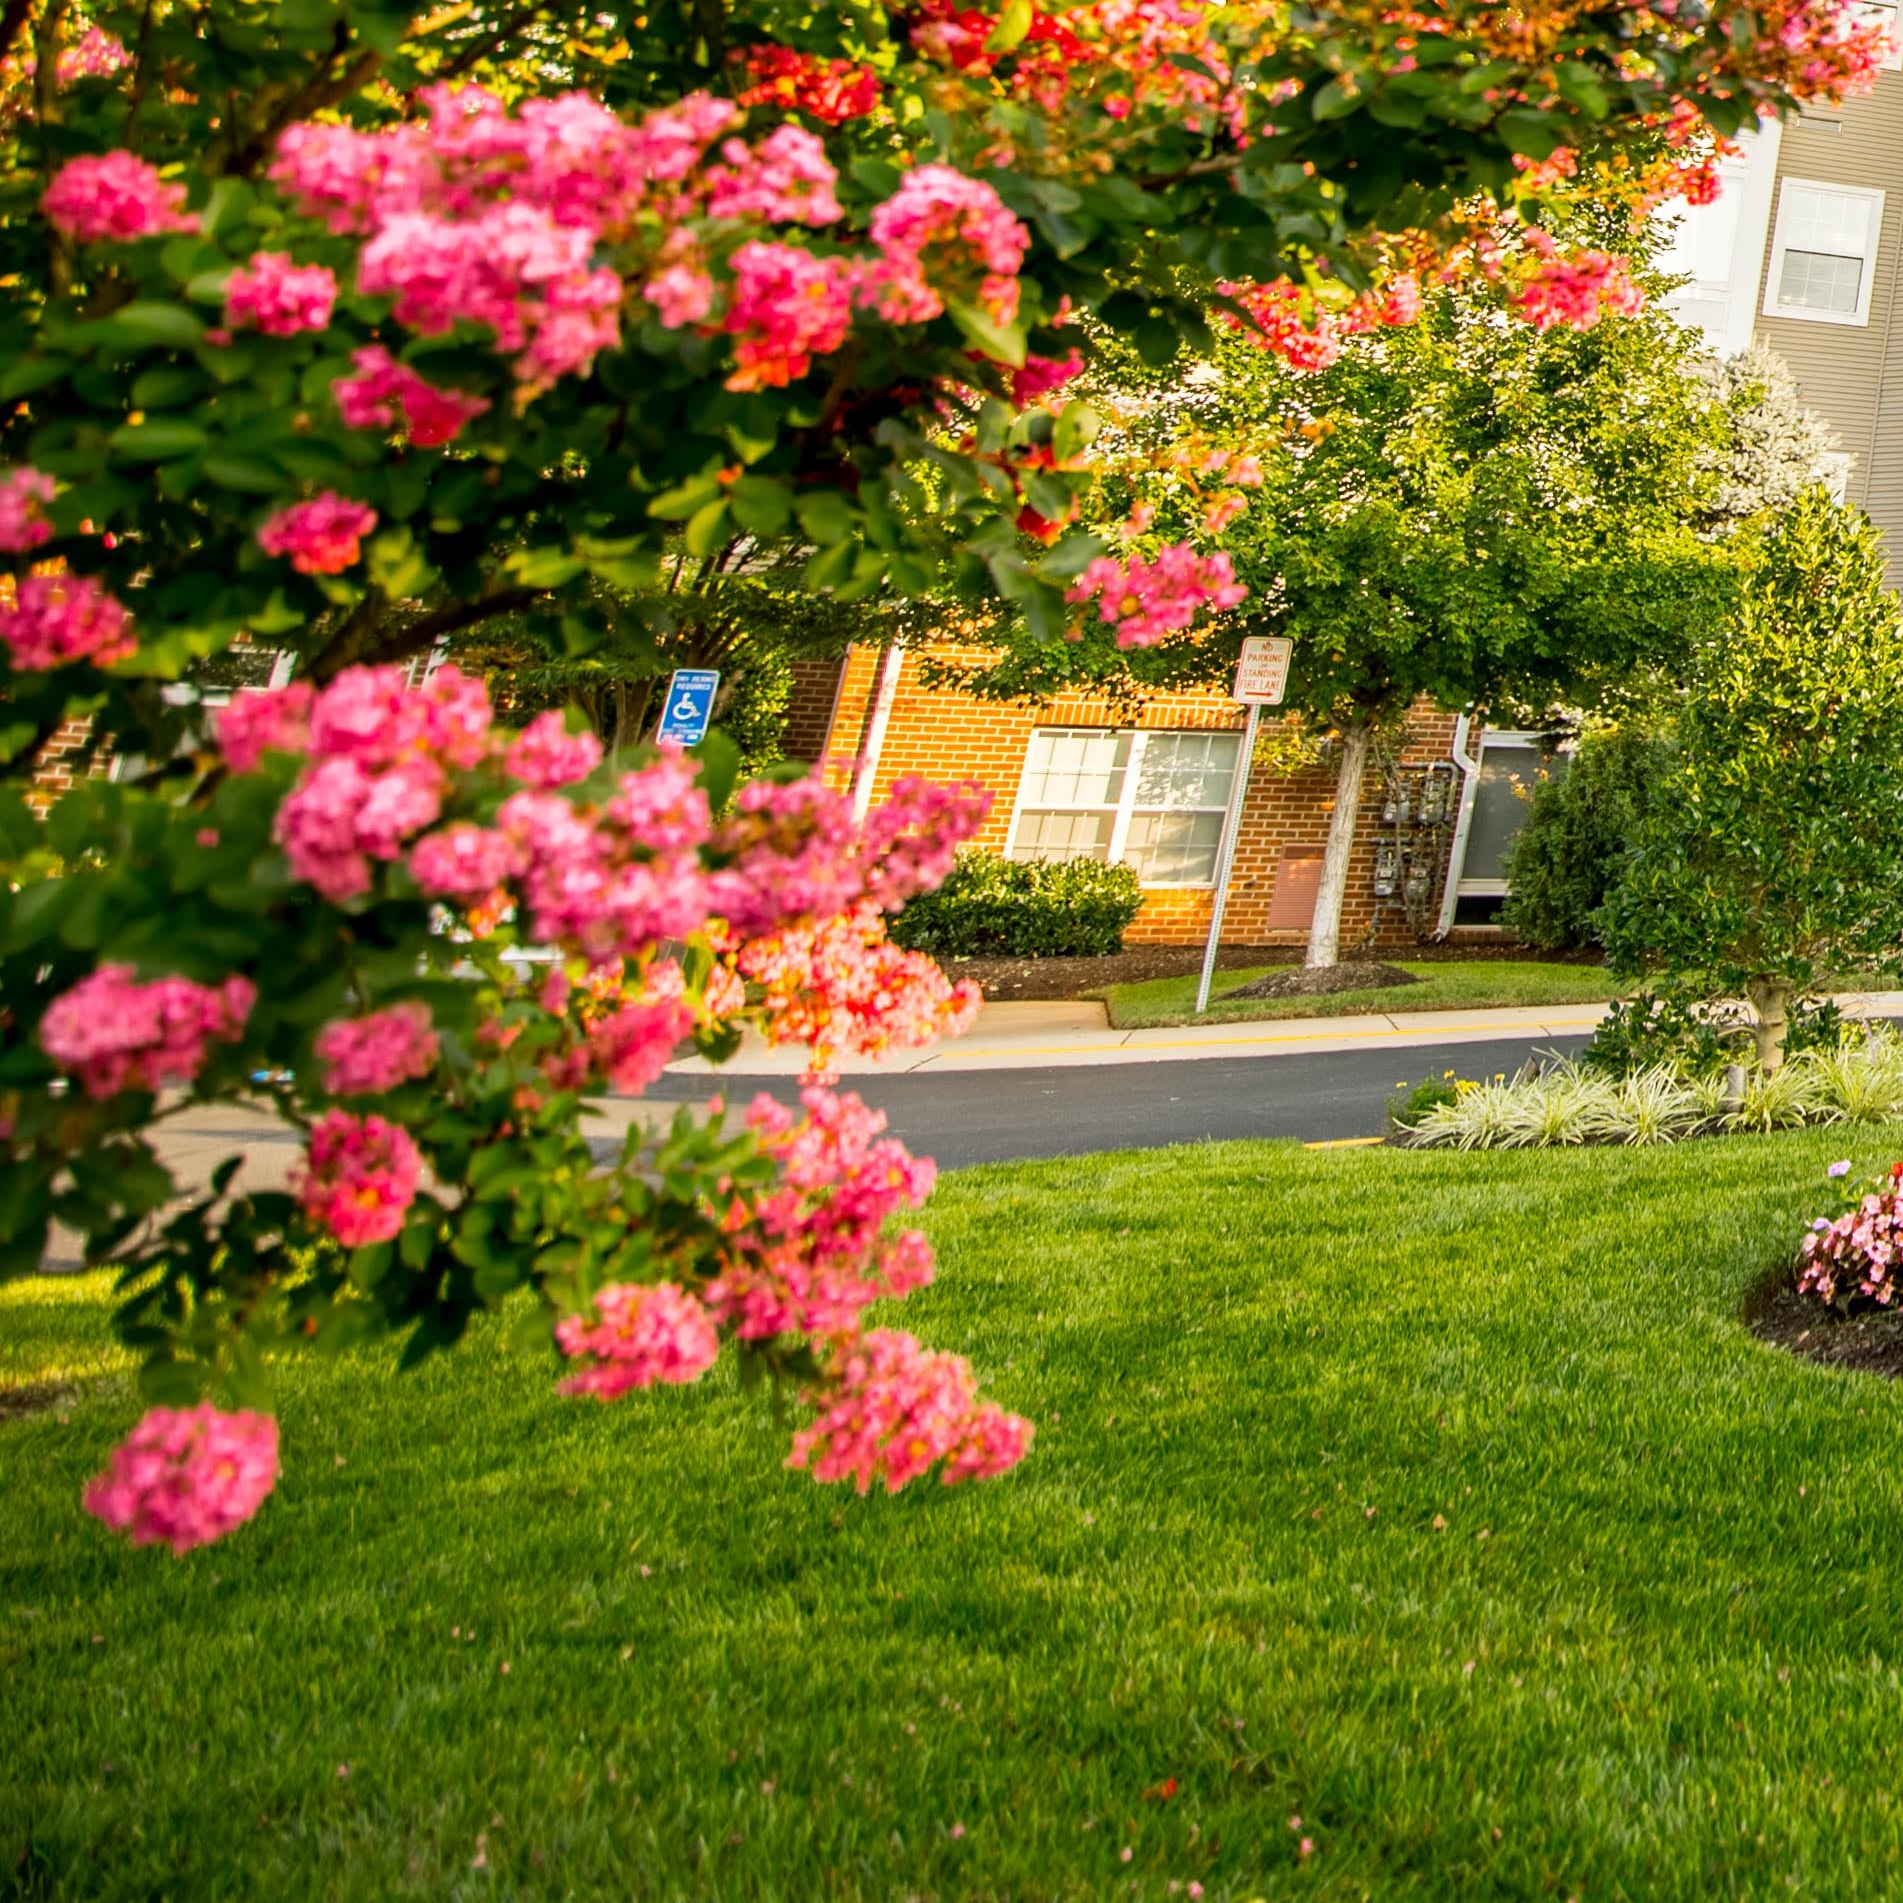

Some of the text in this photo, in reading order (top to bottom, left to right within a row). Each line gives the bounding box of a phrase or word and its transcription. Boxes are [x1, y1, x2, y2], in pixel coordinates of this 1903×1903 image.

[1262, 643, 1274, 652] NO
[1247, 653, 1283, 663] PARKING
[1243, 668, 1282, 678] STANDING
[1240, 680, 1281, 691] FIRE LANE
